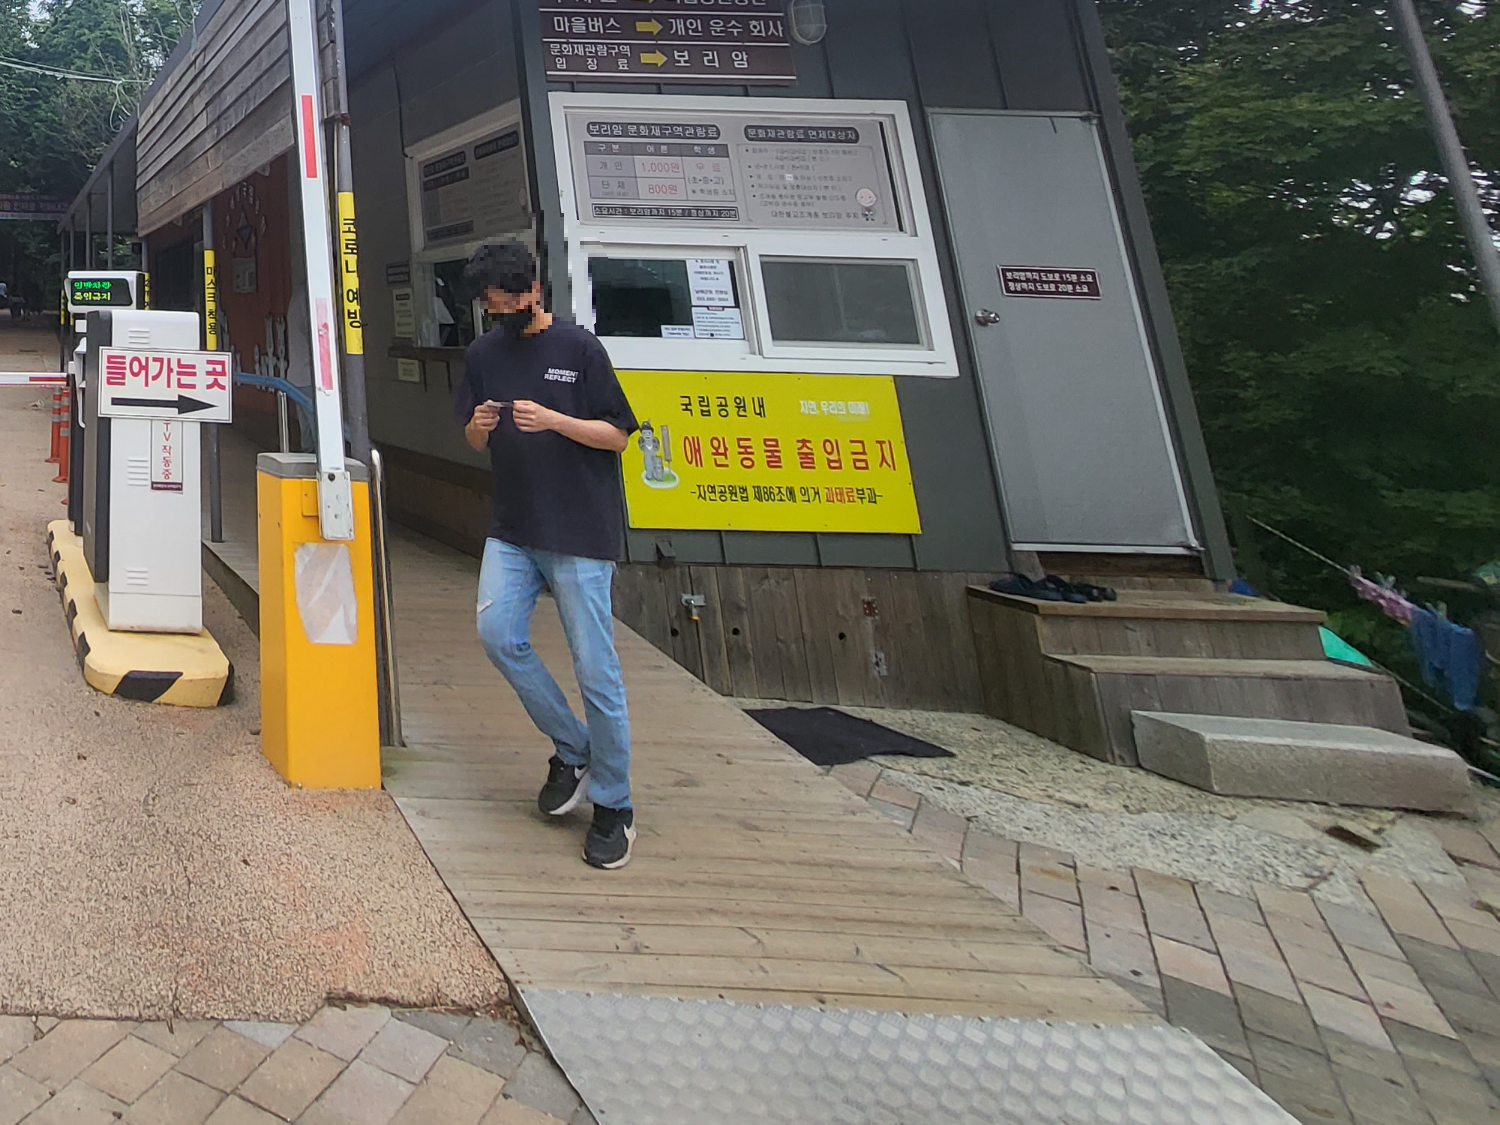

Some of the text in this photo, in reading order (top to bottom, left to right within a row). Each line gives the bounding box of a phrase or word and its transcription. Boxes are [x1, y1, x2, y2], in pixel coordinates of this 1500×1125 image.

[554, 16, 784, 38] 마을버스 개인 운수 회사
[550, 43, 631, 57] 문화재관람구역
[589, 123, 719, 138] 보리암 문화재구역관람료
[747, 128, 856, 140] 문화재관람료 면제대상자
[648, 184, 678, 195] 800원
[106, 355, 227, 391] 들어가는 곳
[544, 373, 576, 383] REFLECT
[548, 367, 579, 377] MOMENT
[683, 435, 897, 471] 애완동물 출입금지
[753, 486, 797, 504] 제86조에
[800, 486, 822, 504] 의거
